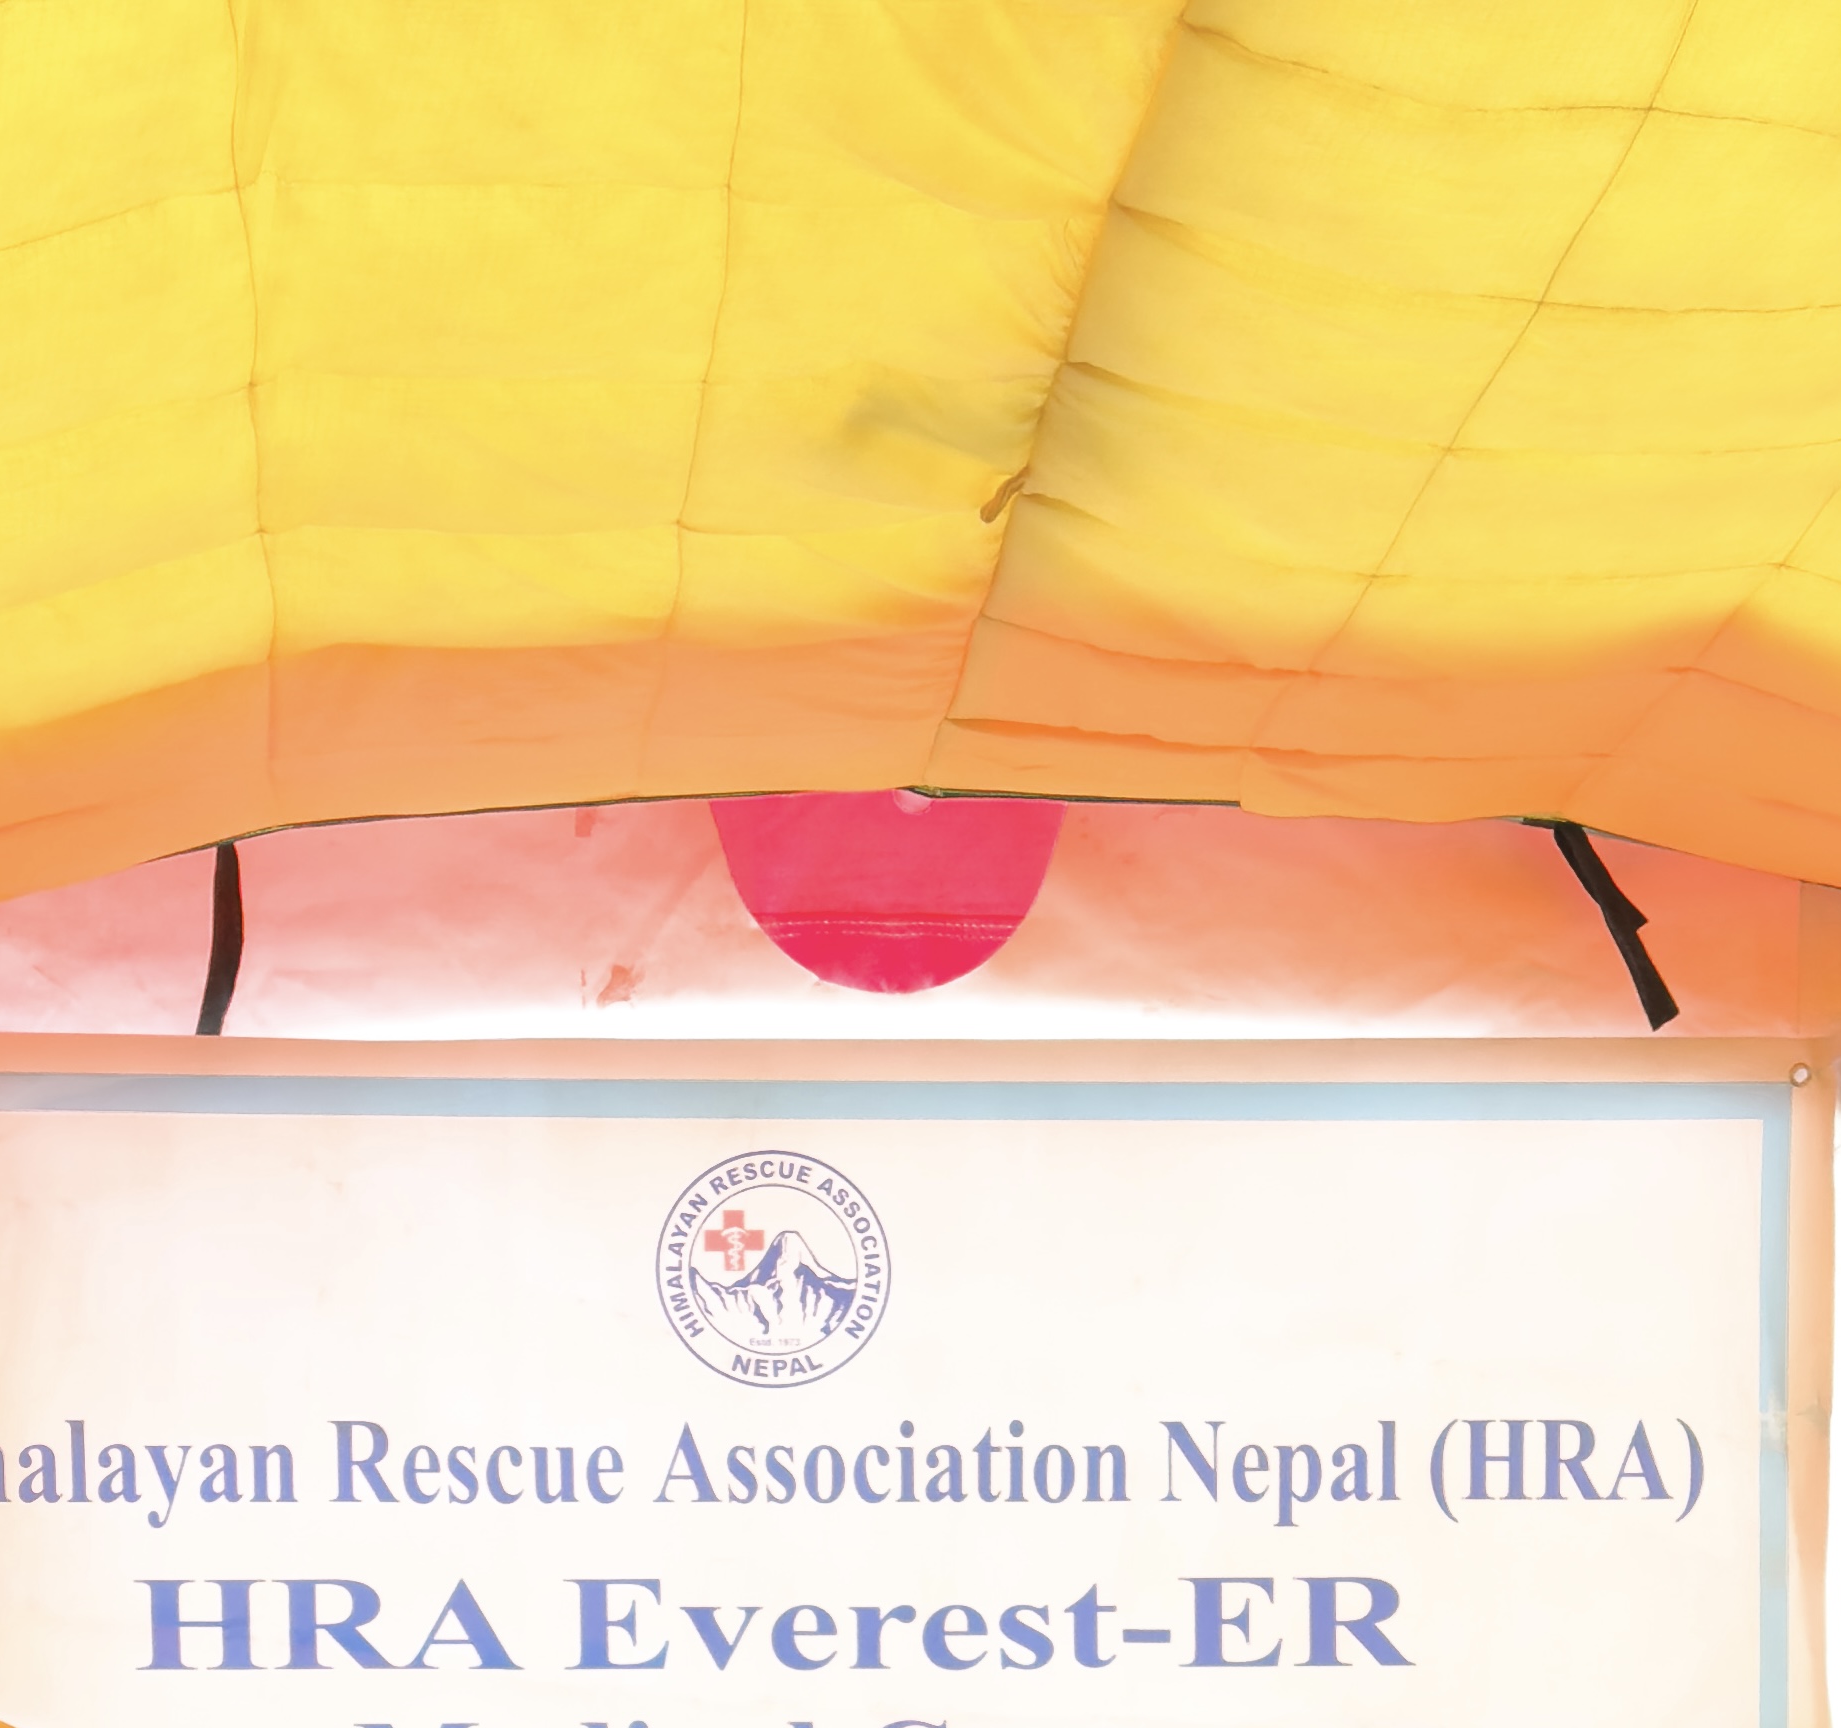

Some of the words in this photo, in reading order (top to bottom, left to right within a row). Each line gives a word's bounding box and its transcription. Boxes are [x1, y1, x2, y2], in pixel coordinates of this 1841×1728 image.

[666, 1192, 709, 1338] HIMALAYAN
[709, 1159, 813, 1196] RESCUE
[816, 1177, 881, 1340] ASSOCIATION
[731, 1354, 824, 1378] NEPAL
[327, 1420, 624, 1505] Rescue
[653, 1419, 1132, 1505] Association
[1159, 1420, 1401, 1528] Nepal
[1429, 1418, 1705, 1523] (HRA)
[133, 1578, 525, 1671] HRA
[563, 1576, 1417, 1671] Everest-ER
